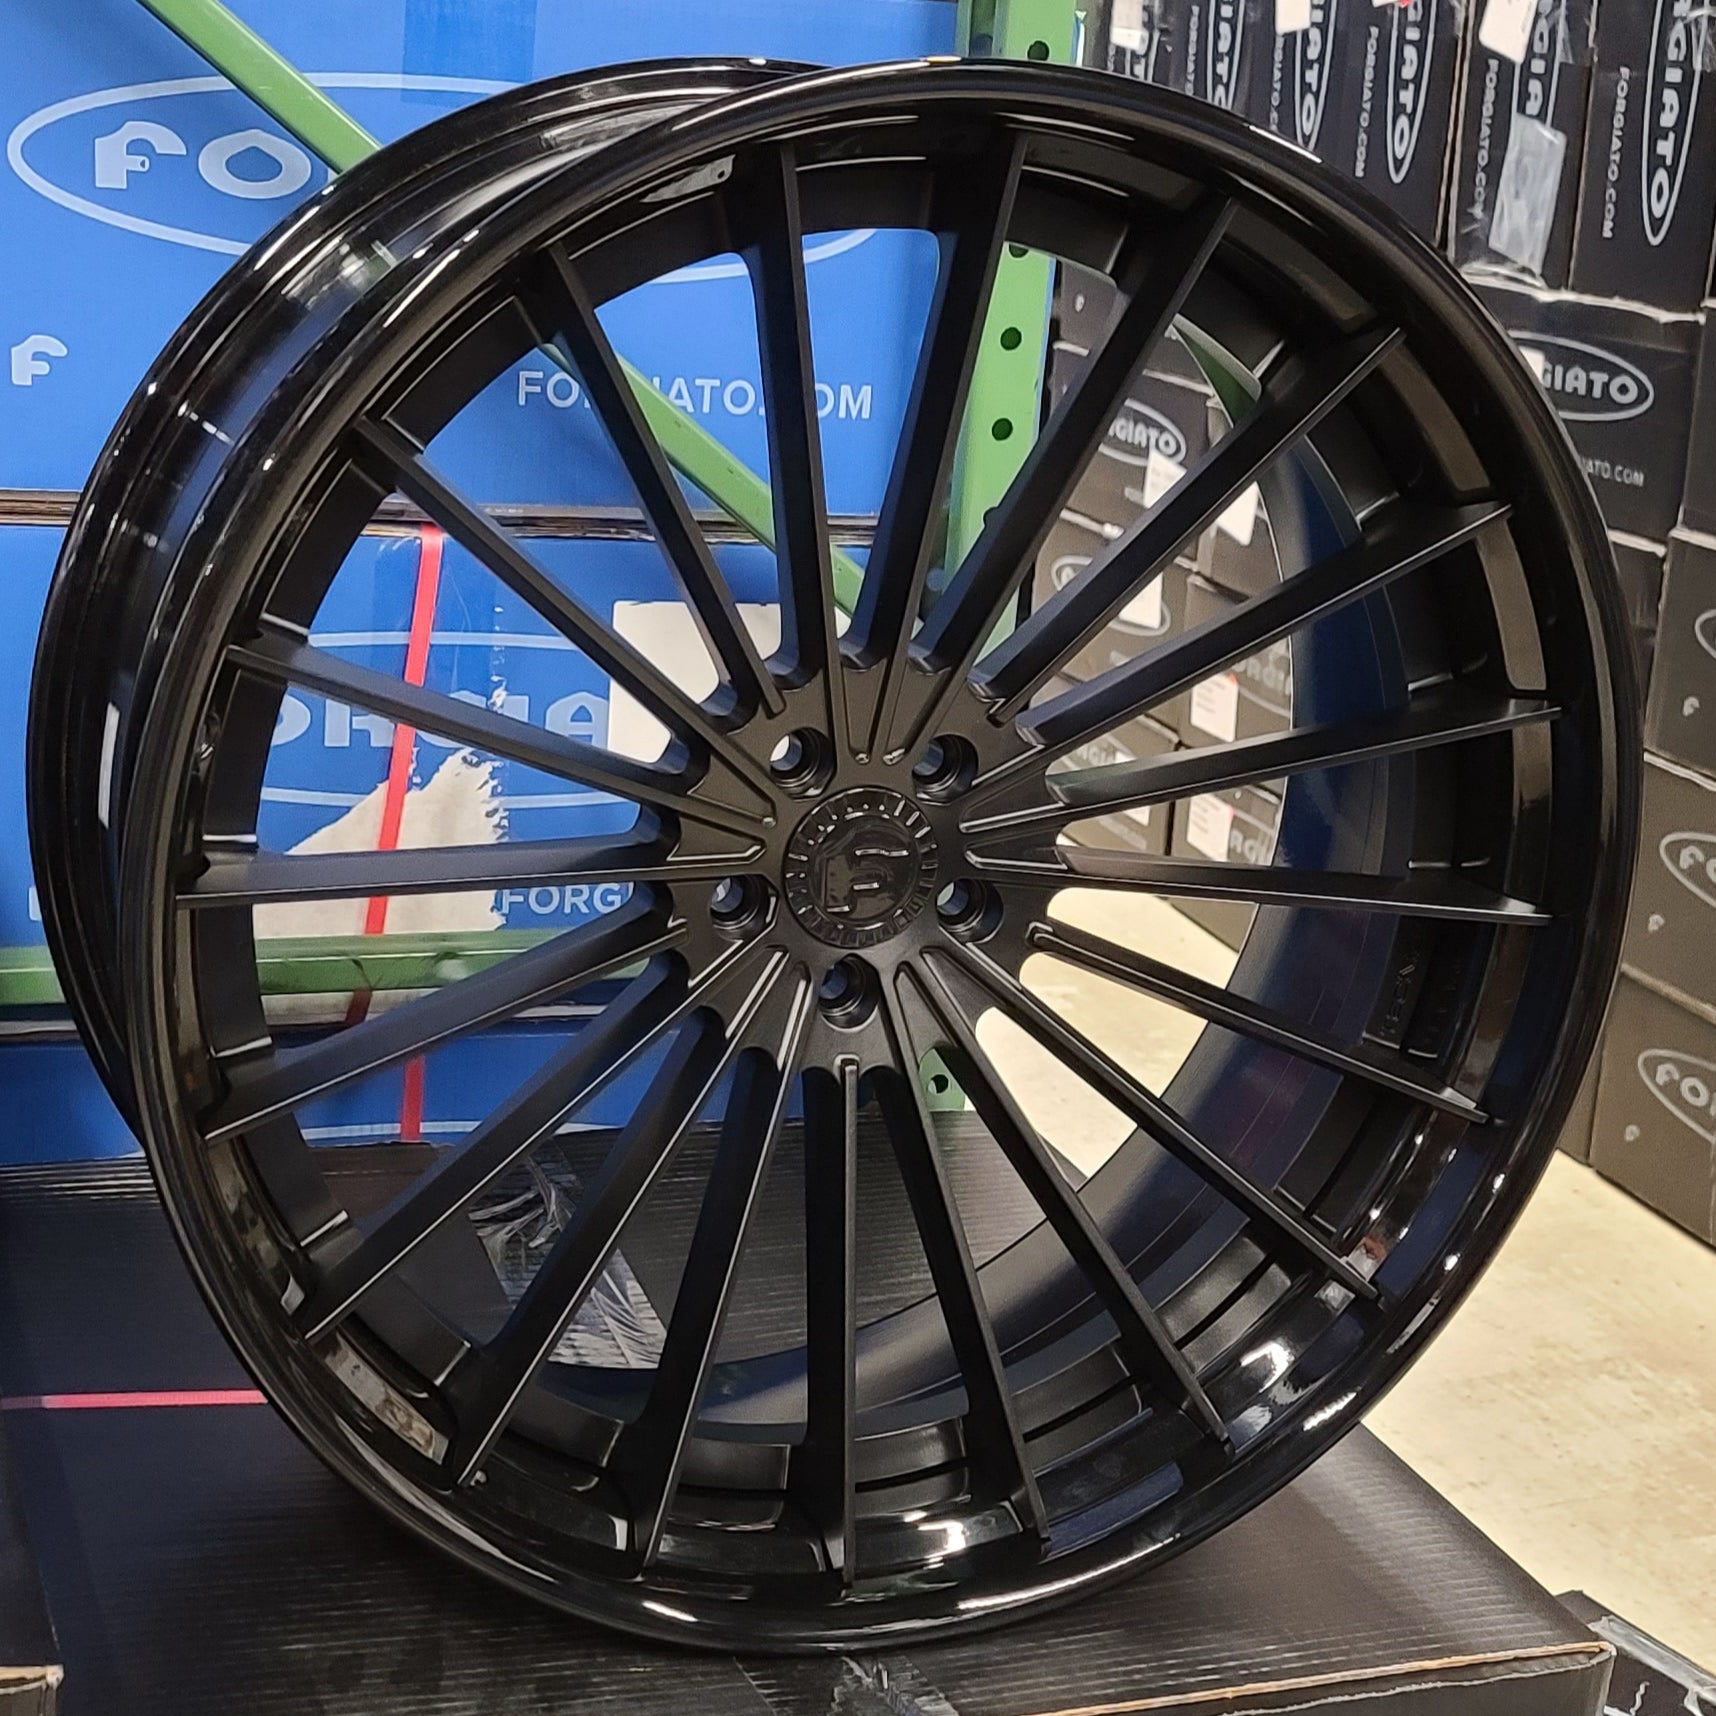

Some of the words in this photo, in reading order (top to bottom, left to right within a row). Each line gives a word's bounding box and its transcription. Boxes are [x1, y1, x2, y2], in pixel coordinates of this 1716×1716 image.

[95, 120, 342, 199] FO
[1355, 26, 1379, 178] FORGIATO.COM
[1602, 66, 1631, 238] FORGIATO.COM
[11, 334, 67, 386] F
